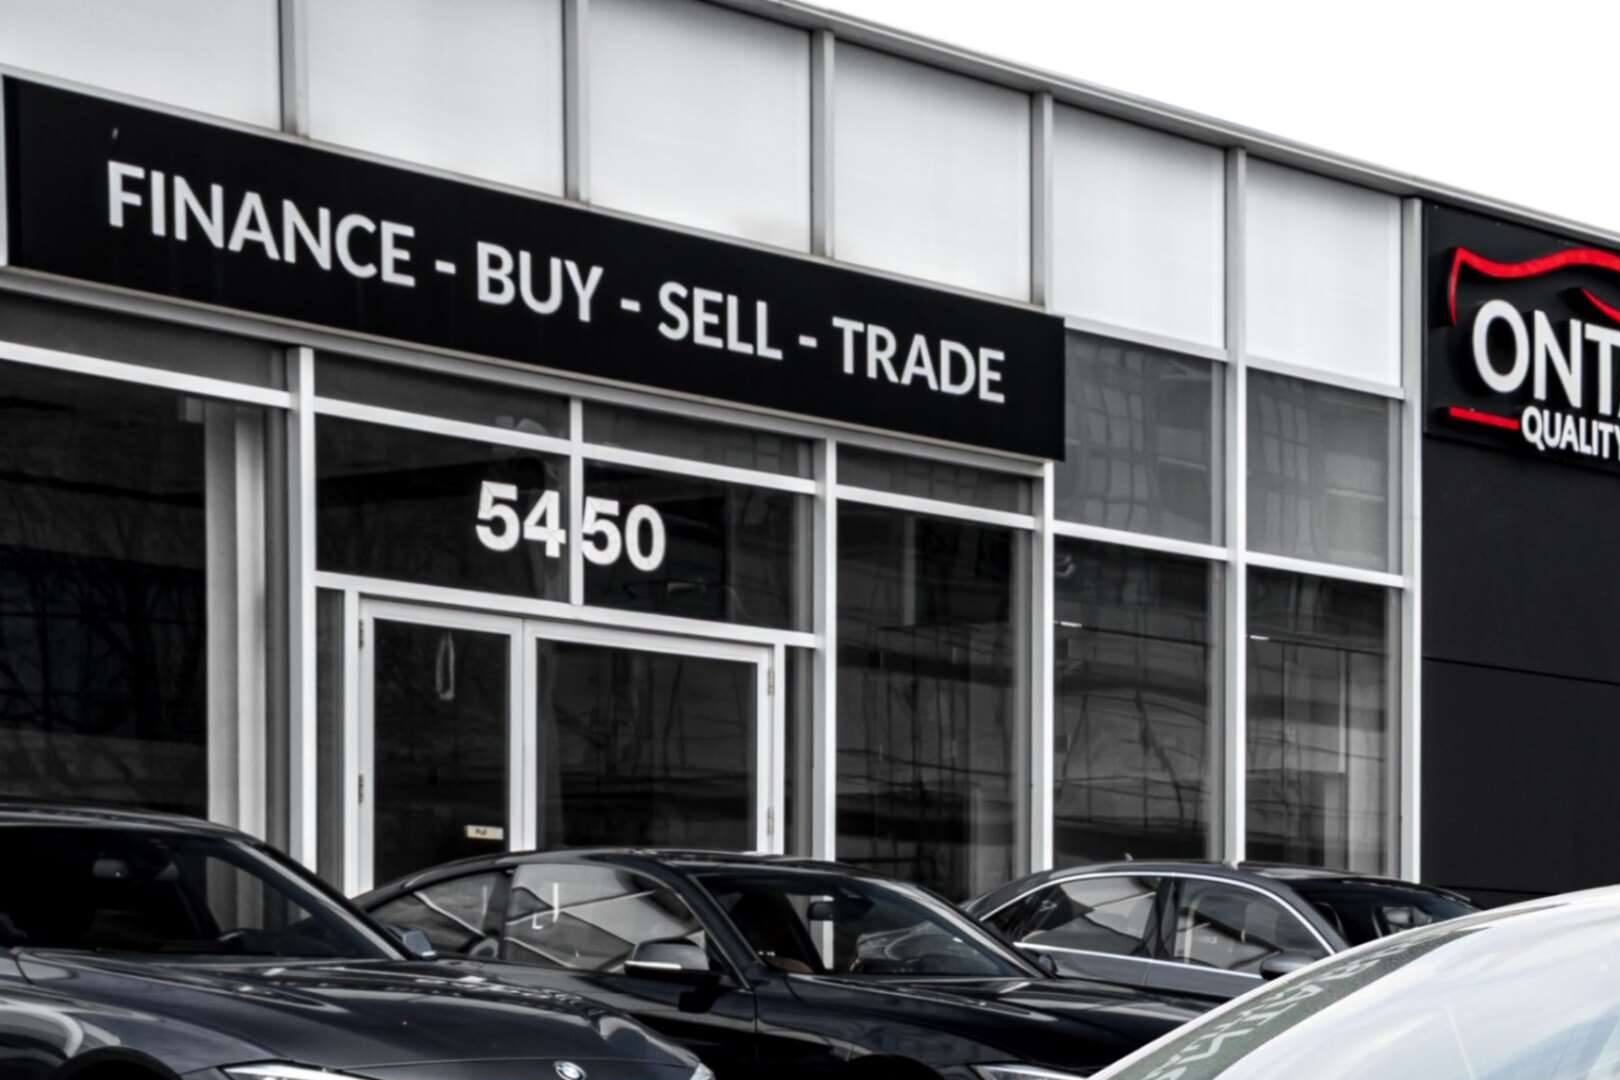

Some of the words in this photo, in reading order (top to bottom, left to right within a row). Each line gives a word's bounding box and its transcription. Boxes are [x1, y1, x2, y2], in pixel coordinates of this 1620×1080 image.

[108, 160, 415, 287] FINANCE
[477, 241, 603, 322] BUY
[659, 281, 783, 360] SELL
[832, 316, 1005, 403] TRADE
[476, 481, 666, 571] 5450
